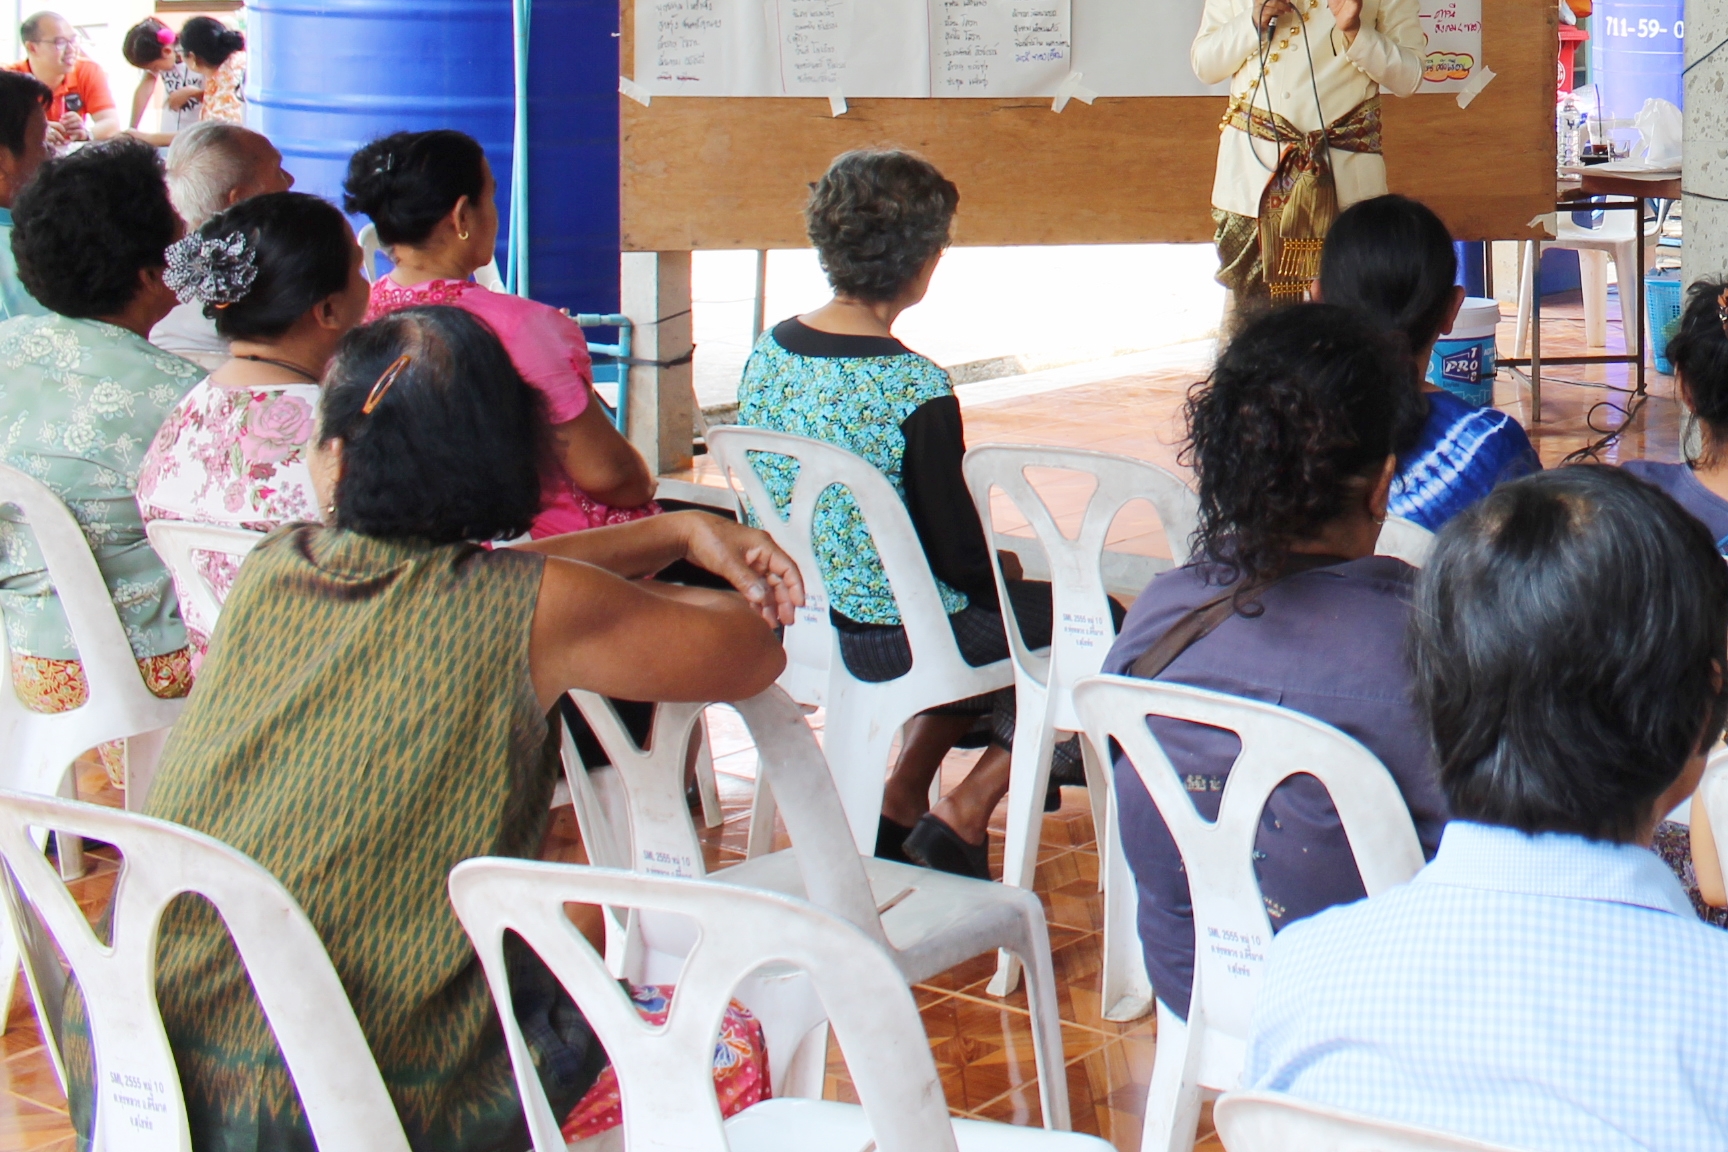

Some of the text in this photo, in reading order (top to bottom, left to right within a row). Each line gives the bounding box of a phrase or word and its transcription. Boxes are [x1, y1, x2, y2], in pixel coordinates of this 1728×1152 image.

[1222, 929, 1239, 942] 2555
[1251, 934, 1261, 945] 10
[124, 1074, 141, 1089] 2555
[154, 1081, 164, 1094] 10
